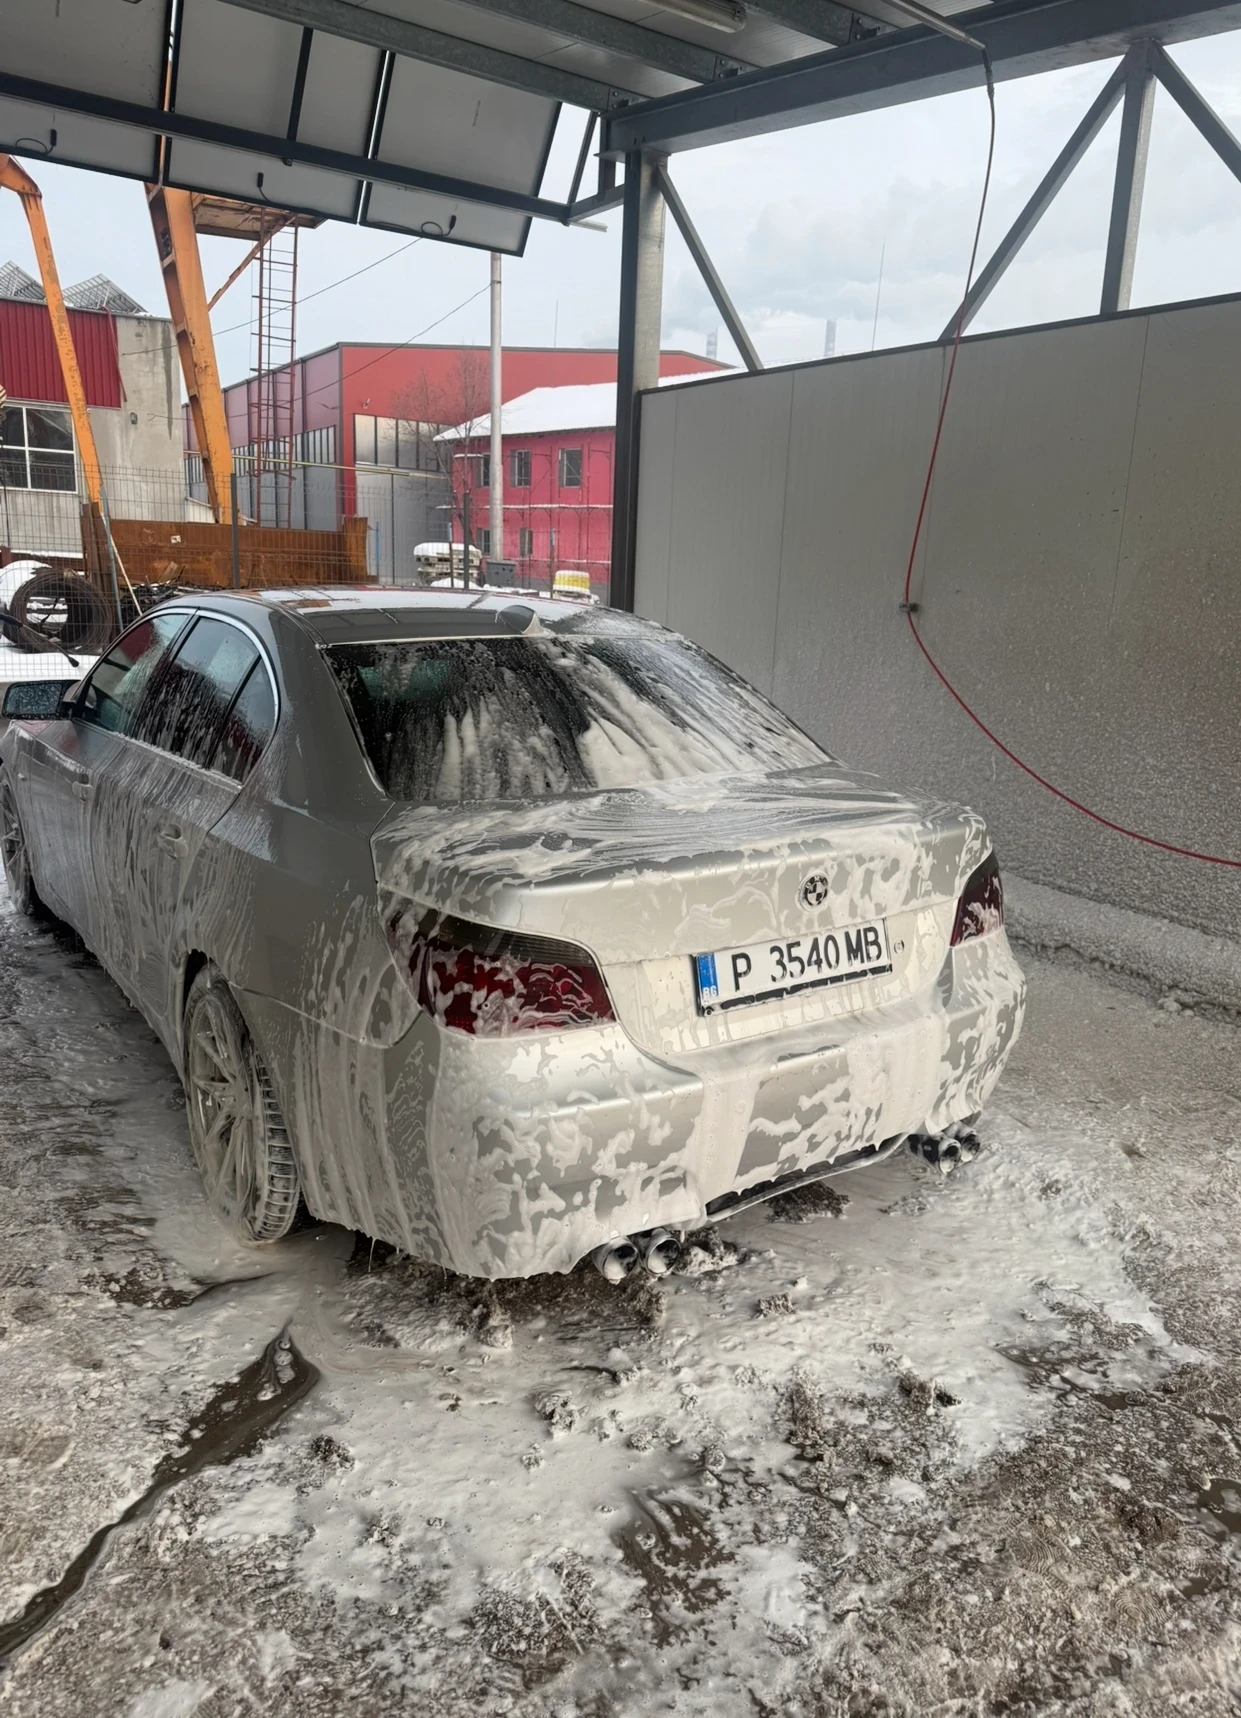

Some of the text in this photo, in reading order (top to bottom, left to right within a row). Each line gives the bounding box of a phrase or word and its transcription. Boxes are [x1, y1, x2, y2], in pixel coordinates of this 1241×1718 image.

[731, 926, 882, 992] P 3540 MB
[703, 985, 717, 998] BG
